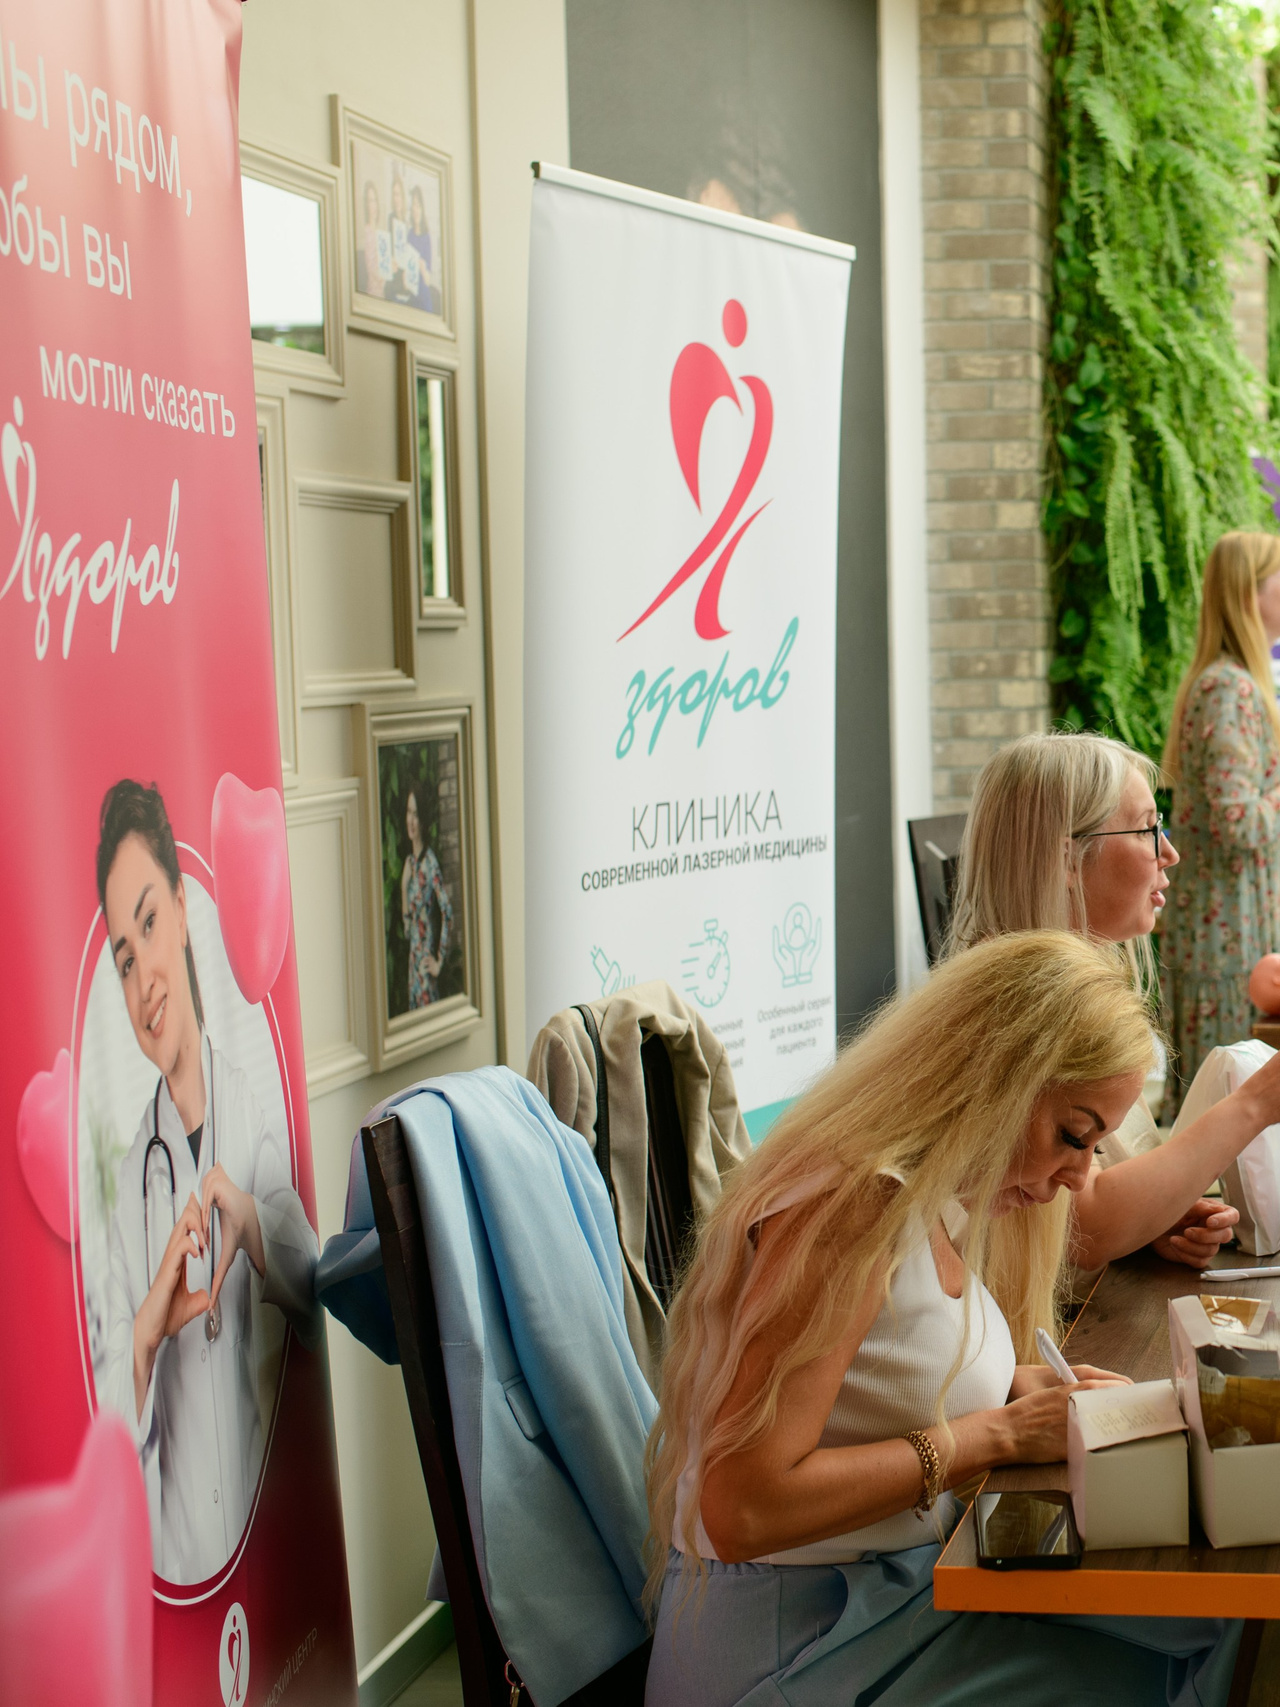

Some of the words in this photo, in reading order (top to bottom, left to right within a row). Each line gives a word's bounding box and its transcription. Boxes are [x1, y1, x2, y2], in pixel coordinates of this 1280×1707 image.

[0, 25, 49, 130] ы
[64, 69, 192, 217] рядом,
[83, 223, 132, 300] вы
[39, 345, 135, 416] могли
[141, 372, 236, 438] сказать
[616, 616, 799, 760] здоров
[632, 789, 782, 852] КЛИНИКА
[581, 852, 679, 892] СОВРЕМЕННОЙ
[682, 841, 751, 874] ЛАЗЕРНОЙ
[754, 834, 828, 862] МЕДИЦИНЫ
[292, 1627, 318, 1675] ЦЕНТР
